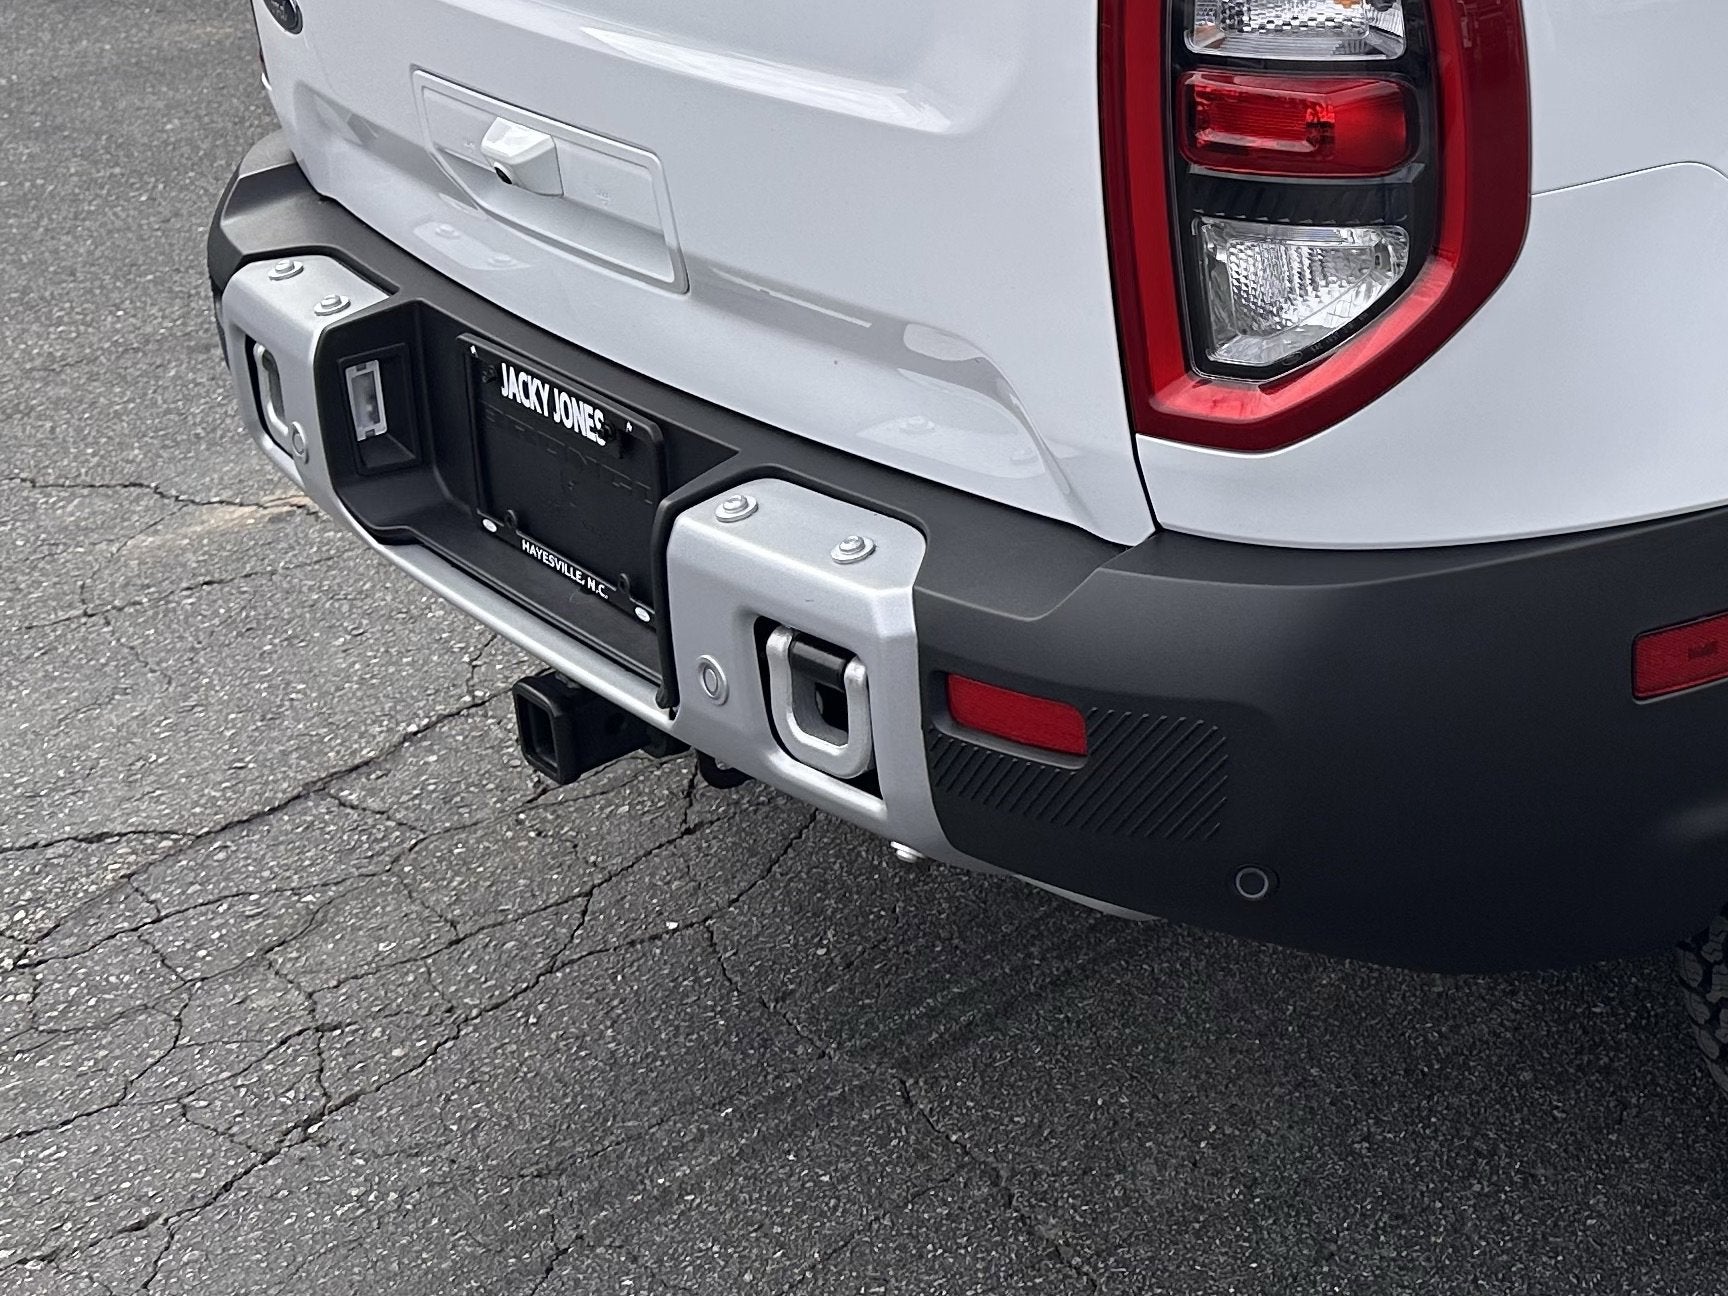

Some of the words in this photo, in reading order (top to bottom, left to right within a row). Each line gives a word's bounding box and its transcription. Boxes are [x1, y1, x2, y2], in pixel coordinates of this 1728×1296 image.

[501, 362, 551, 418] JACKY
[553, 387, 607, 447] JONES
[521, 538, 586, 586] HAYESVILLE,
[587, 576, 609, 600] N.C.
